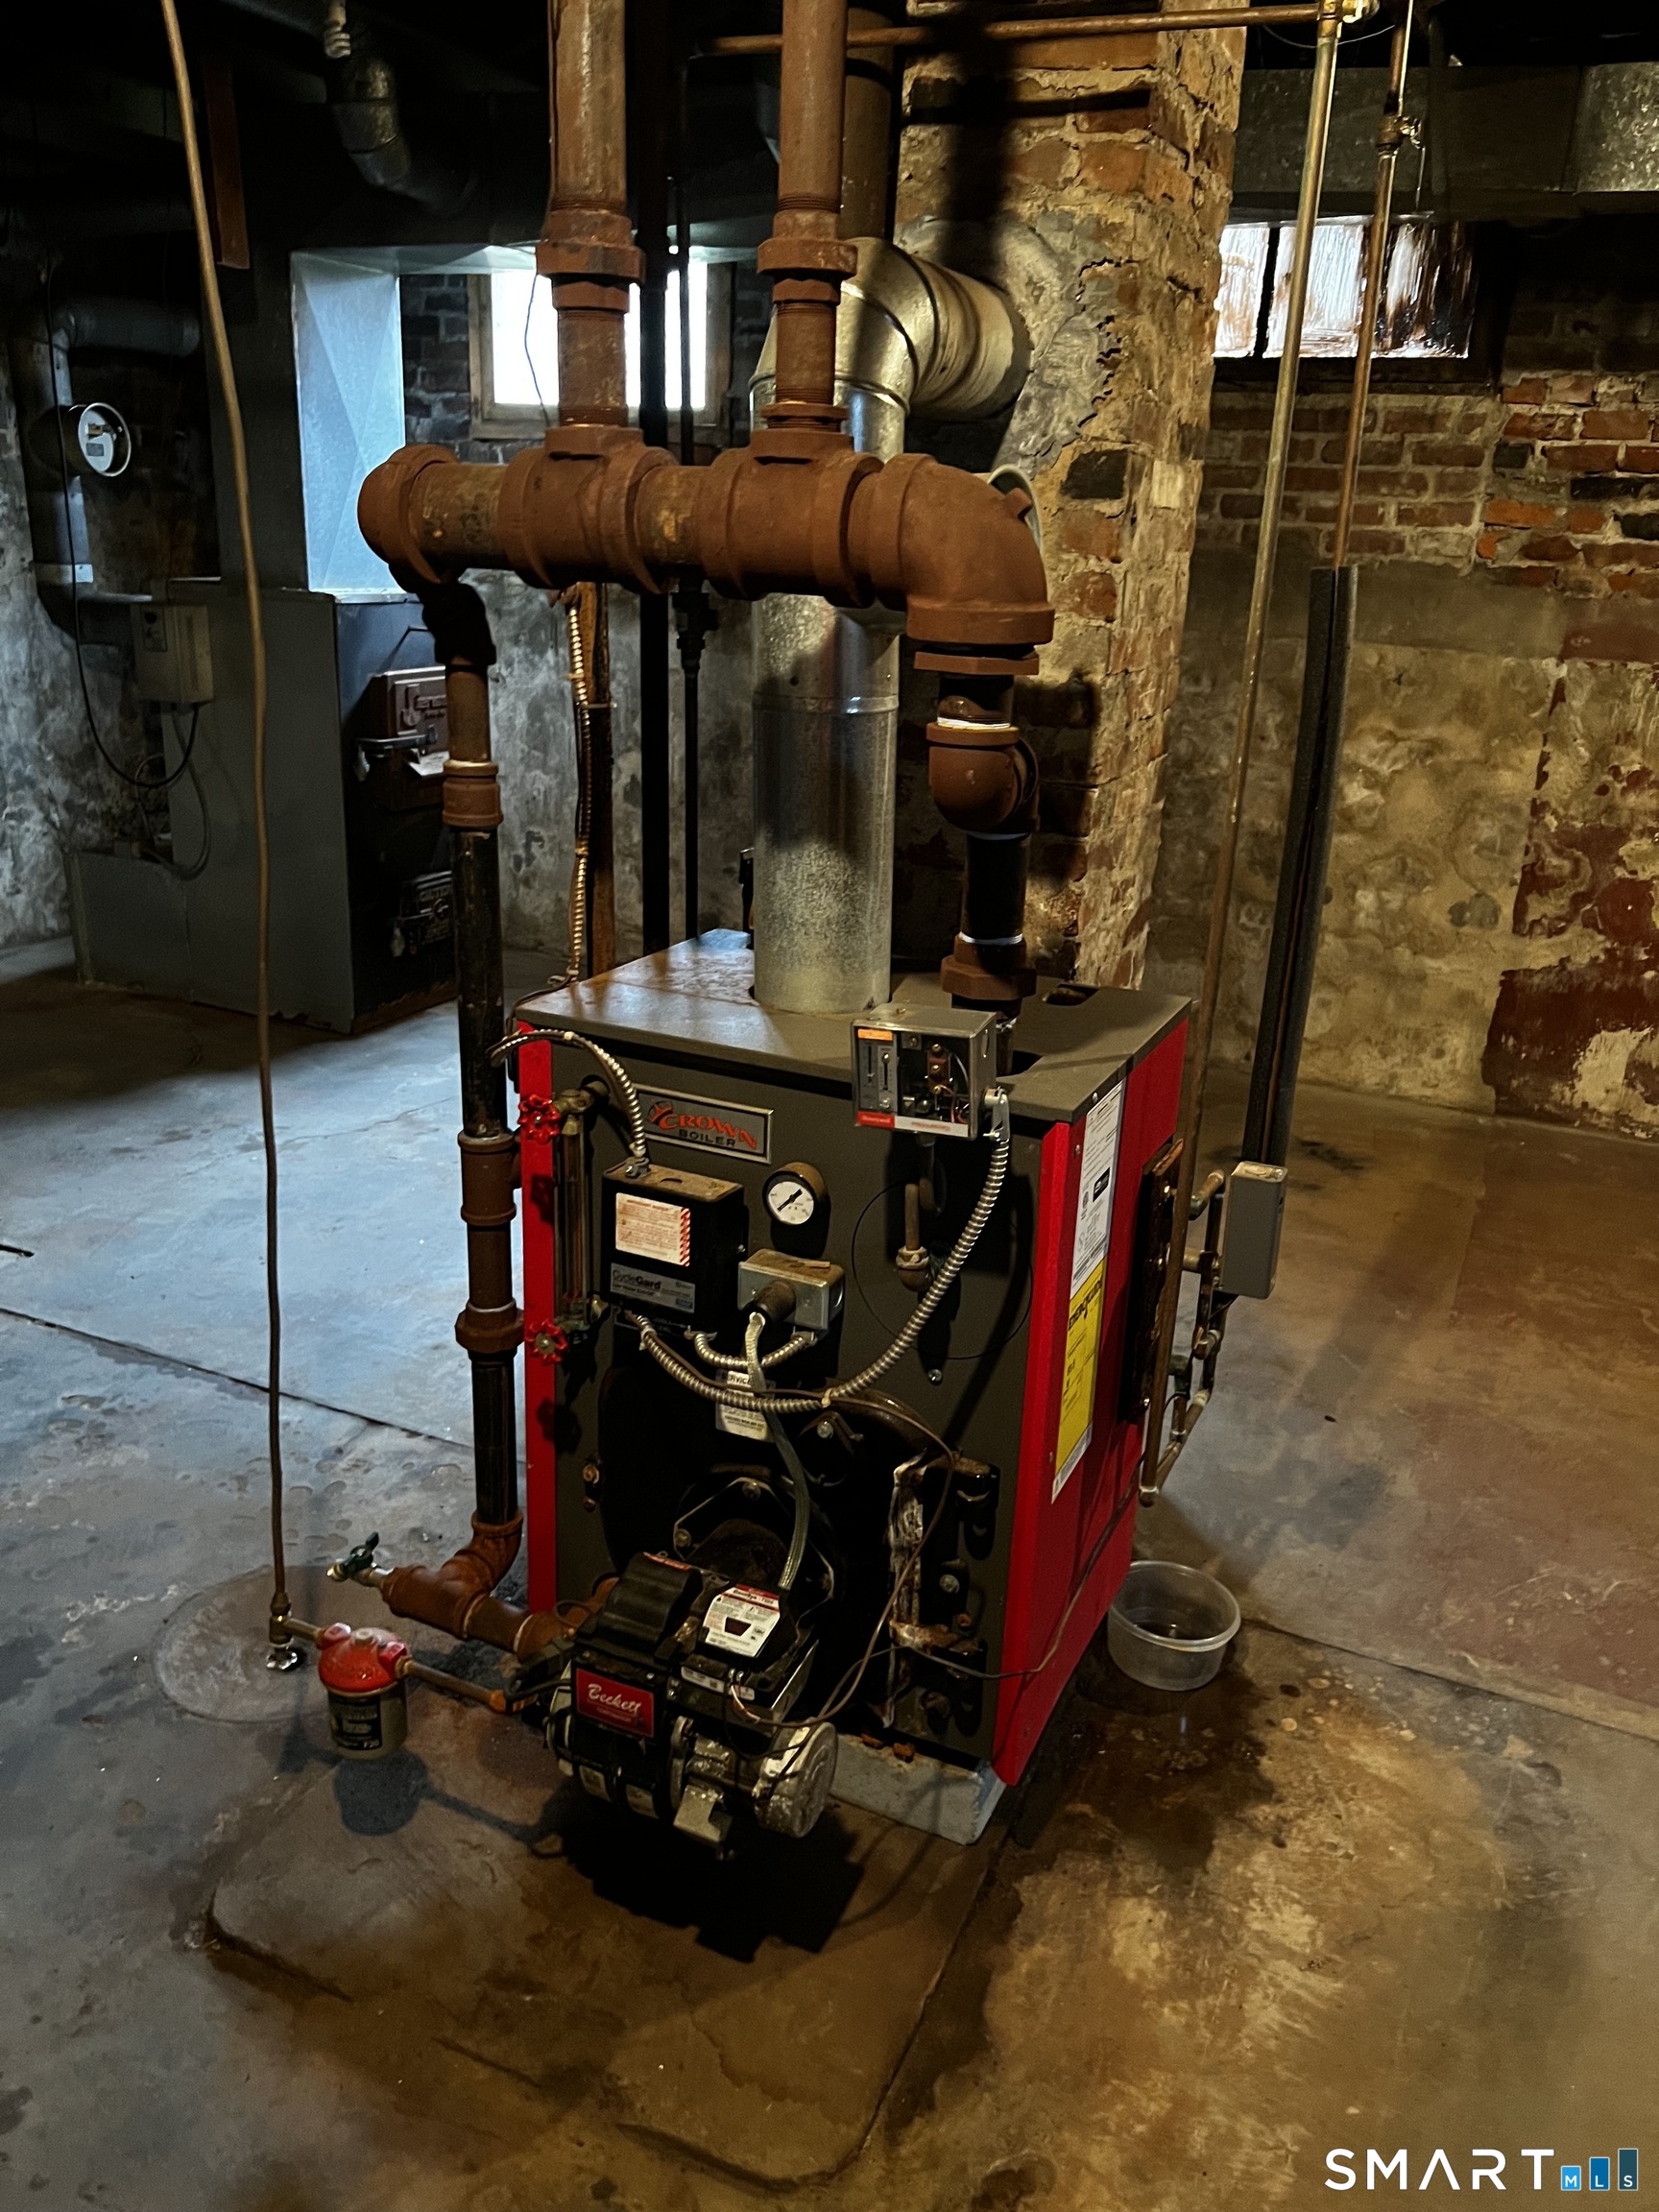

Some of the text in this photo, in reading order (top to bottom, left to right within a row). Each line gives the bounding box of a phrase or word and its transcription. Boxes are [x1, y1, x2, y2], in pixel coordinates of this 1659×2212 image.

[658, 1114, 757, 1150] CROWN
[679, 1128, 736, 1147] BOILER
[588, 1683, 642, 1716] Beckett
